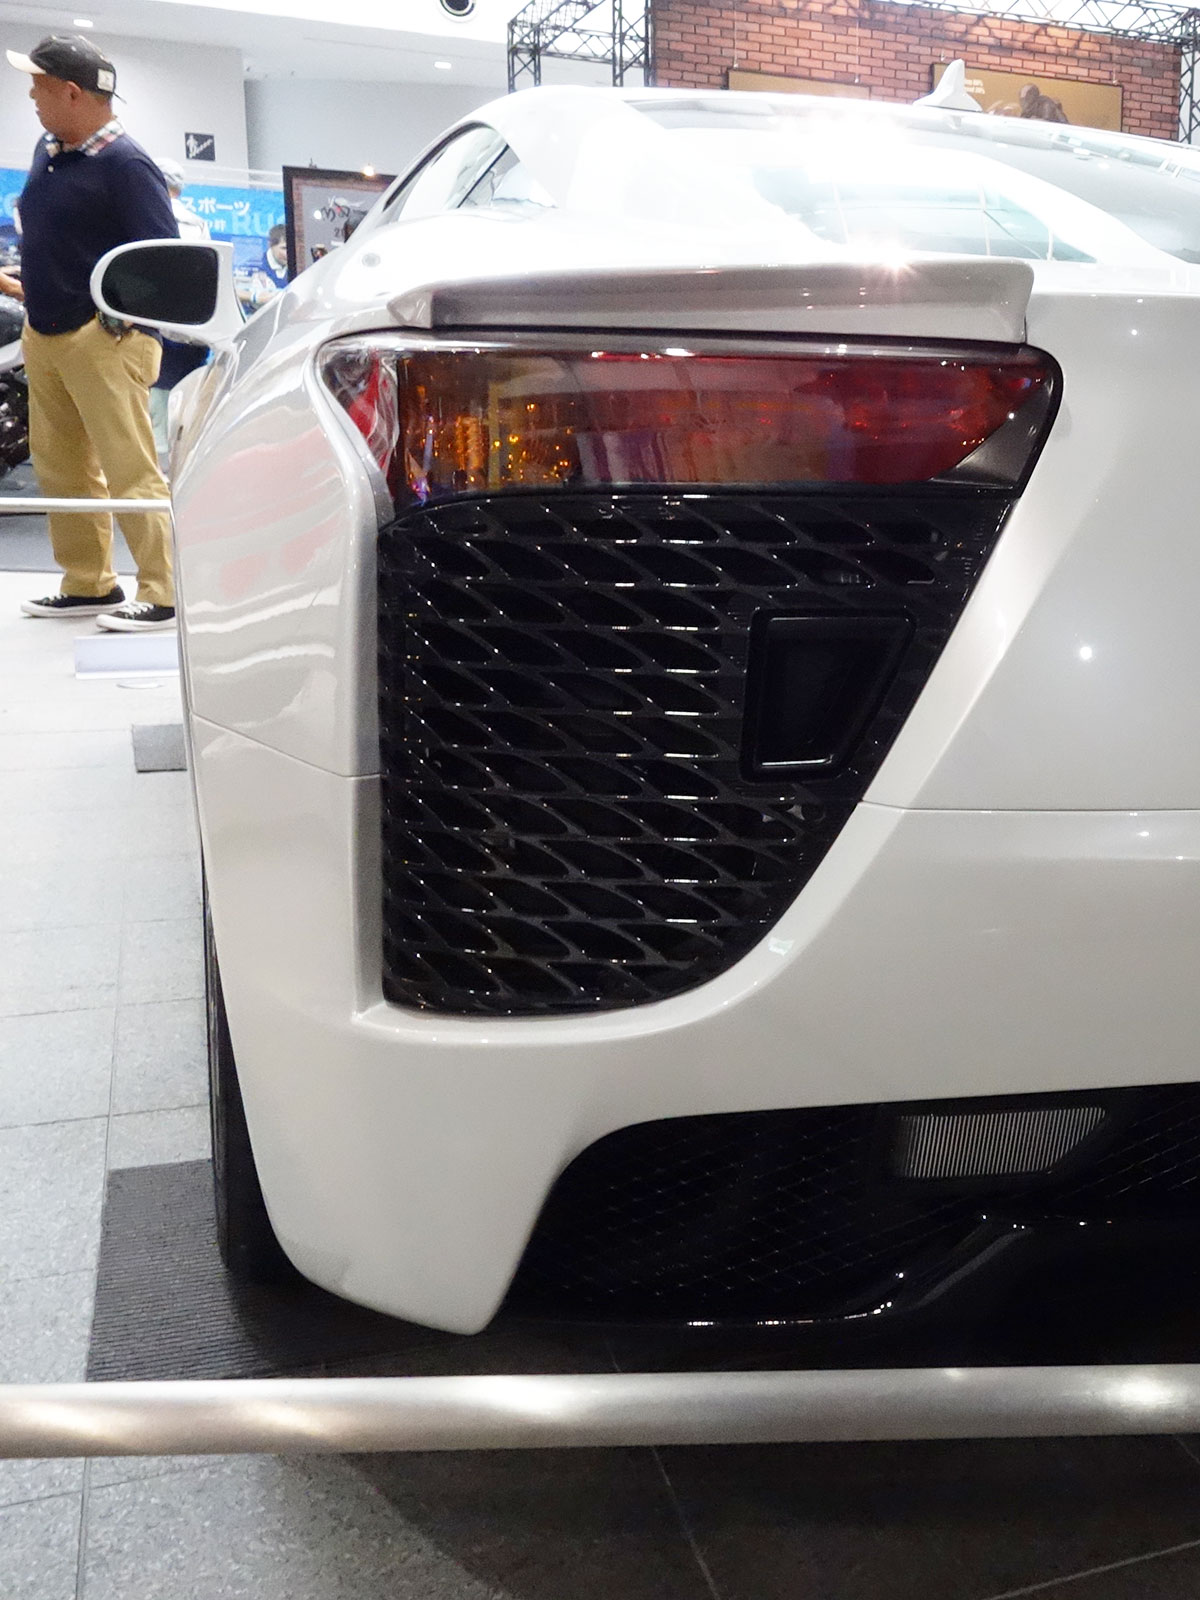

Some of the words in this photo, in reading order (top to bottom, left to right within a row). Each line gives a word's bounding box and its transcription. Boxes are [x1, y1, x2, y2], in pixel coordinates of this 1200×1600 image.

[181, 196, 250, 216] スポーツ
[232, 210, 286, 237] RU
